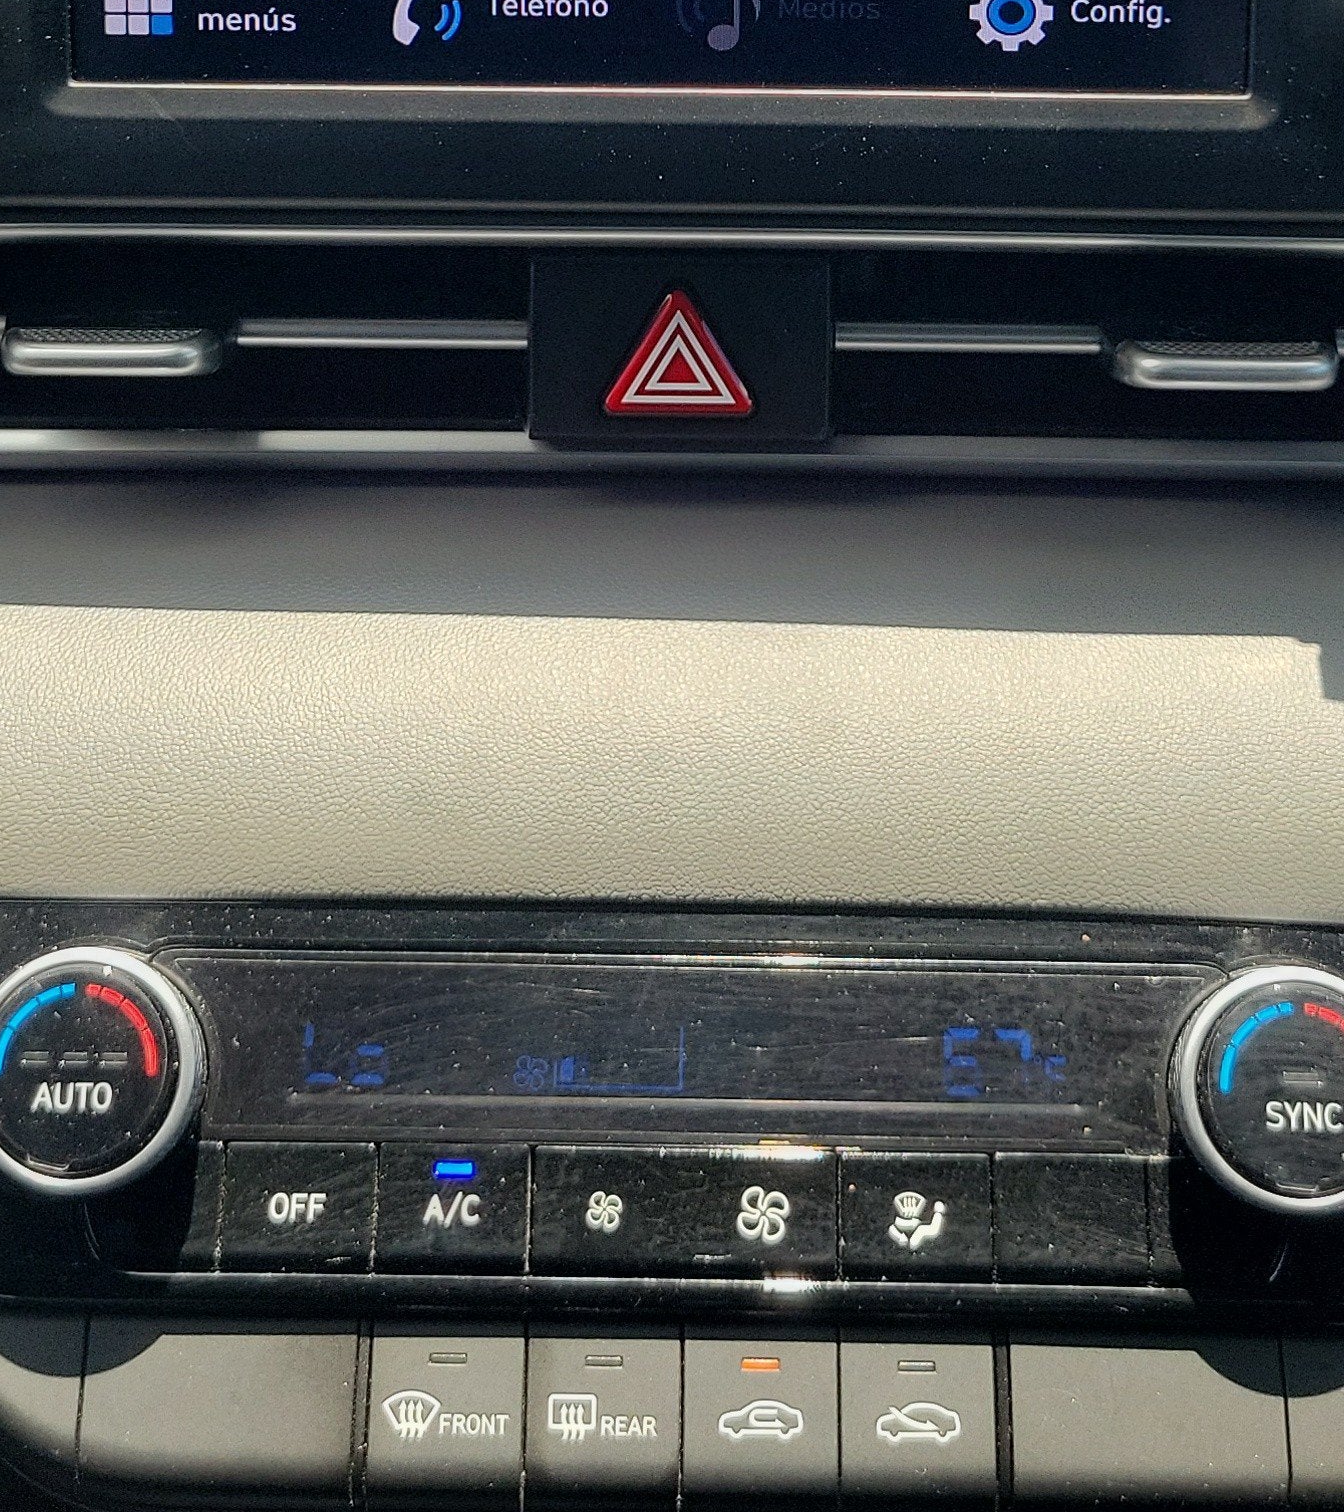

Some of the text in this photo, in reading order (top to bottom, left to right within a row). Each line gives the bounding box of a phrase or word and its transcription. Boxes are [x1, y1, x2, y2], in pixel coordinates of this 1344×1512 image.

[197, 7, 298, 32] menús
[30, 1081, 114, 1117] AUTO
[1264, 1099, 1344, 1136] SYNC
[266, 1189, 326, 1225] OFF
[422, 1192, 482, 1228] A/C
[436, 1411, 511, 1439] FRONT
[599, 1413, 658, 1438] REAR
